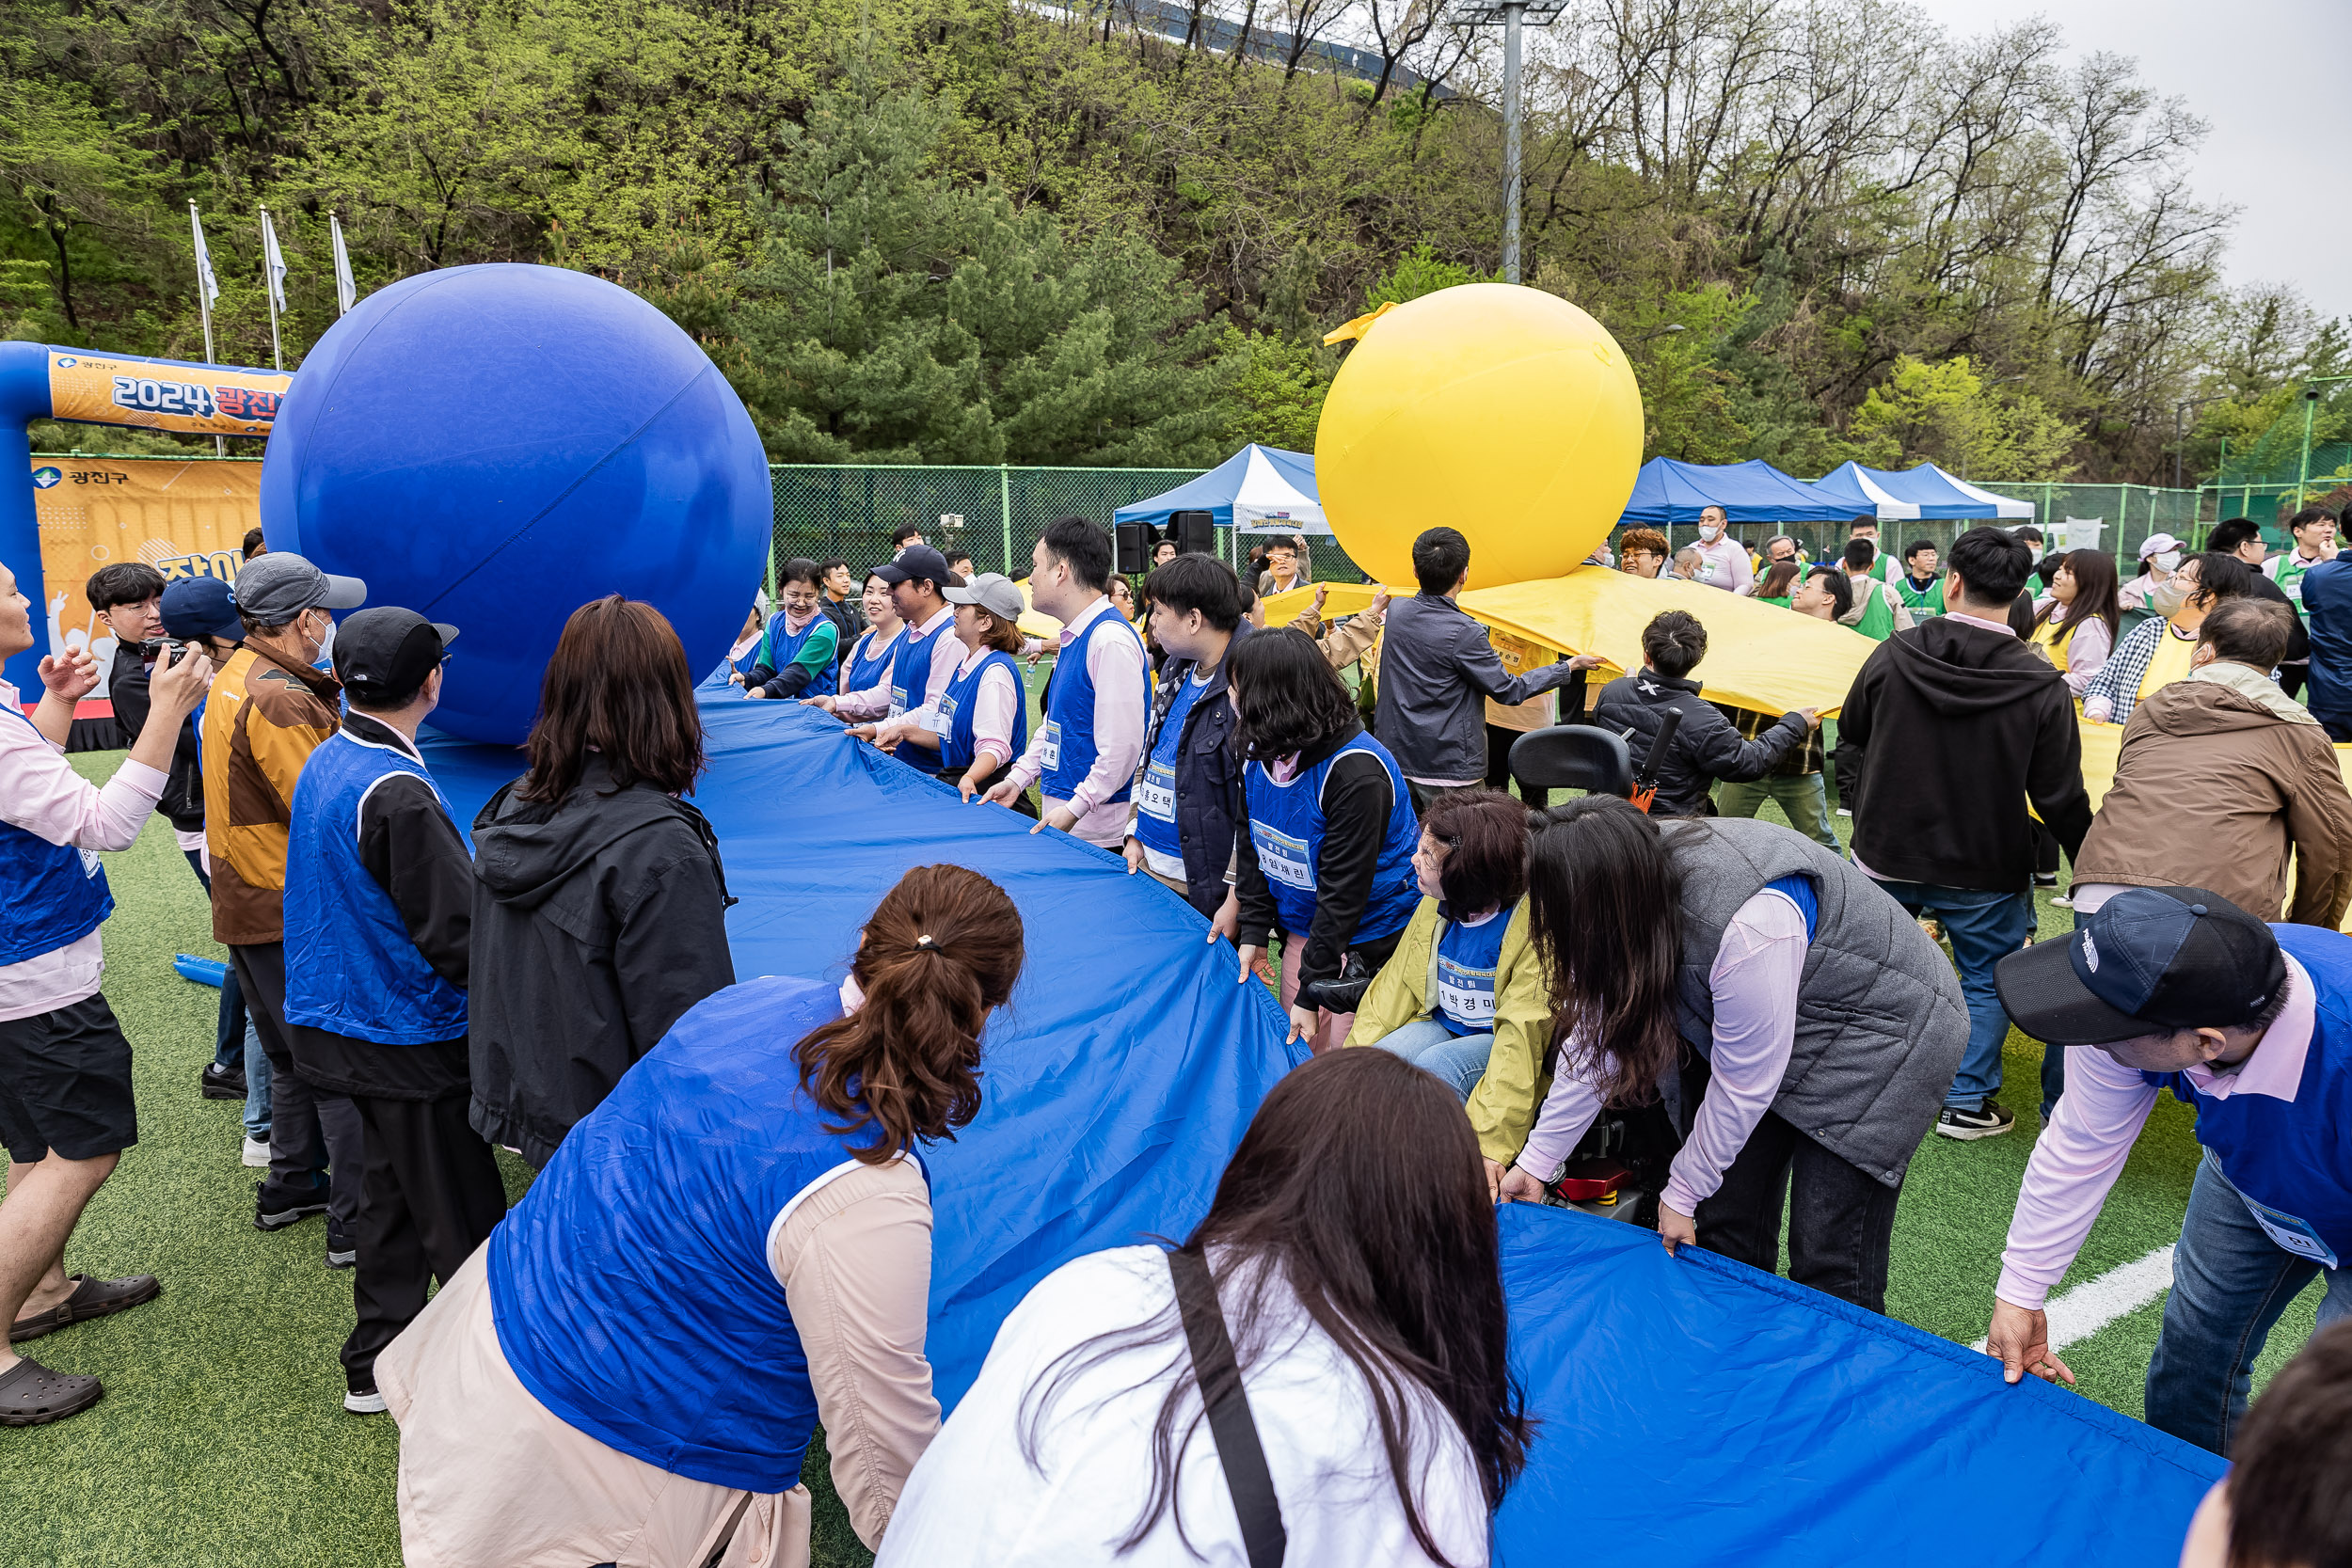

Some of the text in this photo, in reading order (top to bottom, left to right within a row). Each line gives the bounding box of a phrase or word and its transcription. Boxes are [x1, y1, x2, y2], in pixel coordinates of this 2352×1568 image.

[82, 361, 118, 371] 광진구
[113, 376, 284, 417] 2024 광진
[69, 471, 129, 485] 광진구
[1449, 974, 1476, 989] 발전팀
[1449, 992, 1497, 1011] 박경미
